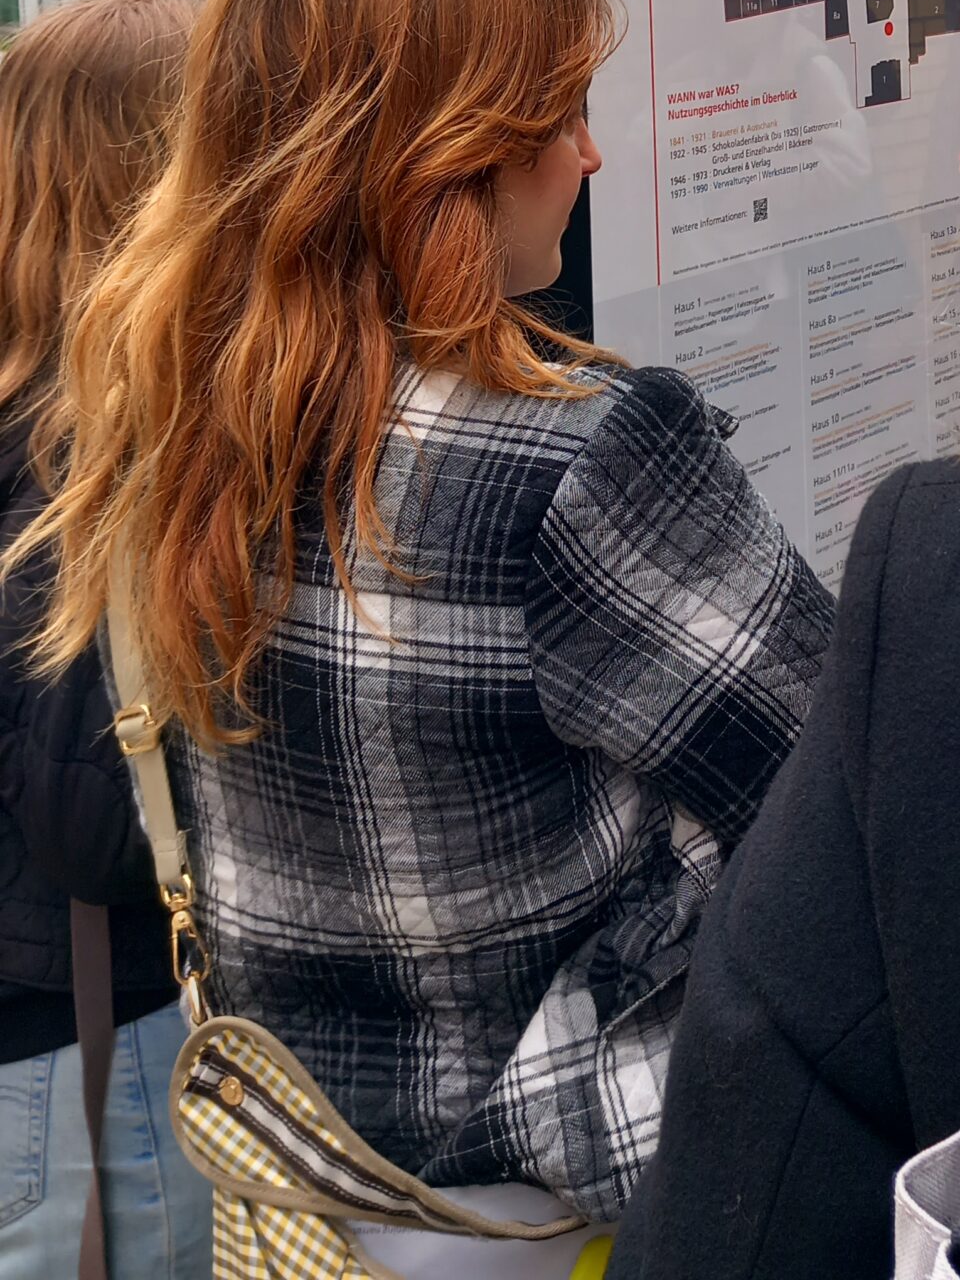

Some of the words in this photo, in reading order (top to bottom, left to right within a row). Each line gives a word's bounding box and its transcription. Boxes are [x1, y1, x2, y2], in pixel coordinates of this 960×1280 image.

[667, 91, 695, 104] WANN
[698, 89, 713, 99] war
[716, 84, 739, 97] WAS?
[668, 98, 749, 120] Nutzungsgeschichte
[751, 96, 760, 105] im
[763, 89, 797, 104] Überblick
[670, 137, 684, 147] 1841
[692, 133, 706, 142] 1921
[712, 128, 738, 139] Brauerei
[670, 149, 685, 160] 1922
[692, 145, 707, 155] 1945
[712, 133, 769, 152] Schokoladenfabrik
[783, 128, 799, 139] 1925)
[803, 120, 838, 134] Gastronomie
[732, 151, 744, 160] und
[746, 144, 784, 158] Einzelhandel
[789, 138, 813, 150] Bäckerei
[671, 176, 686, 186] 1946
[693, 171, 707, 181] 1973
[713, 165, 743, 177] Druckerei
[745, 162, 749, 170] &
[751, 158, 771, 169] Verlag
[671, 189, 686, 199] 1973
[693, 184, 708, 195] 1990
[713, 174, 757, 190] Verwaltungen
[762, 165, 798, 179] Werkstätten
[803, 160, 819, 171] Lager
[672, 221, 698, 235] Weitere
[700, 211, 747, 228] Informationen:
[931, 230, 945, 240] Haus
[947, 226, 956, 235] 13a
[808, 264, 825, 276] Haus
[827, 261, 831, 270] 8
[931, 272, 946, 282] Haus
[948, 268, 955, 276] 14
[674, 302, 694, 314] Haus
[949, 309, 956, 318] 15
[809, 318, 826, 330] Haus
[828, 315, 836, 324] 8a
[676, 351, 695, 364] Haus
[698, 346, 703, 357] 2
[811, 373, 828, 385] Haus
[829, 368, 834, 378] 9
[812, 419, 829, 432] Haus
[832, 413, 839, 424] 10
[813, 475, 831, 488] Haus
[833, 463, 855, 478] 11/11a
[816, 528, 832, 542] Haus
[835, 521, 842, 531] 12
